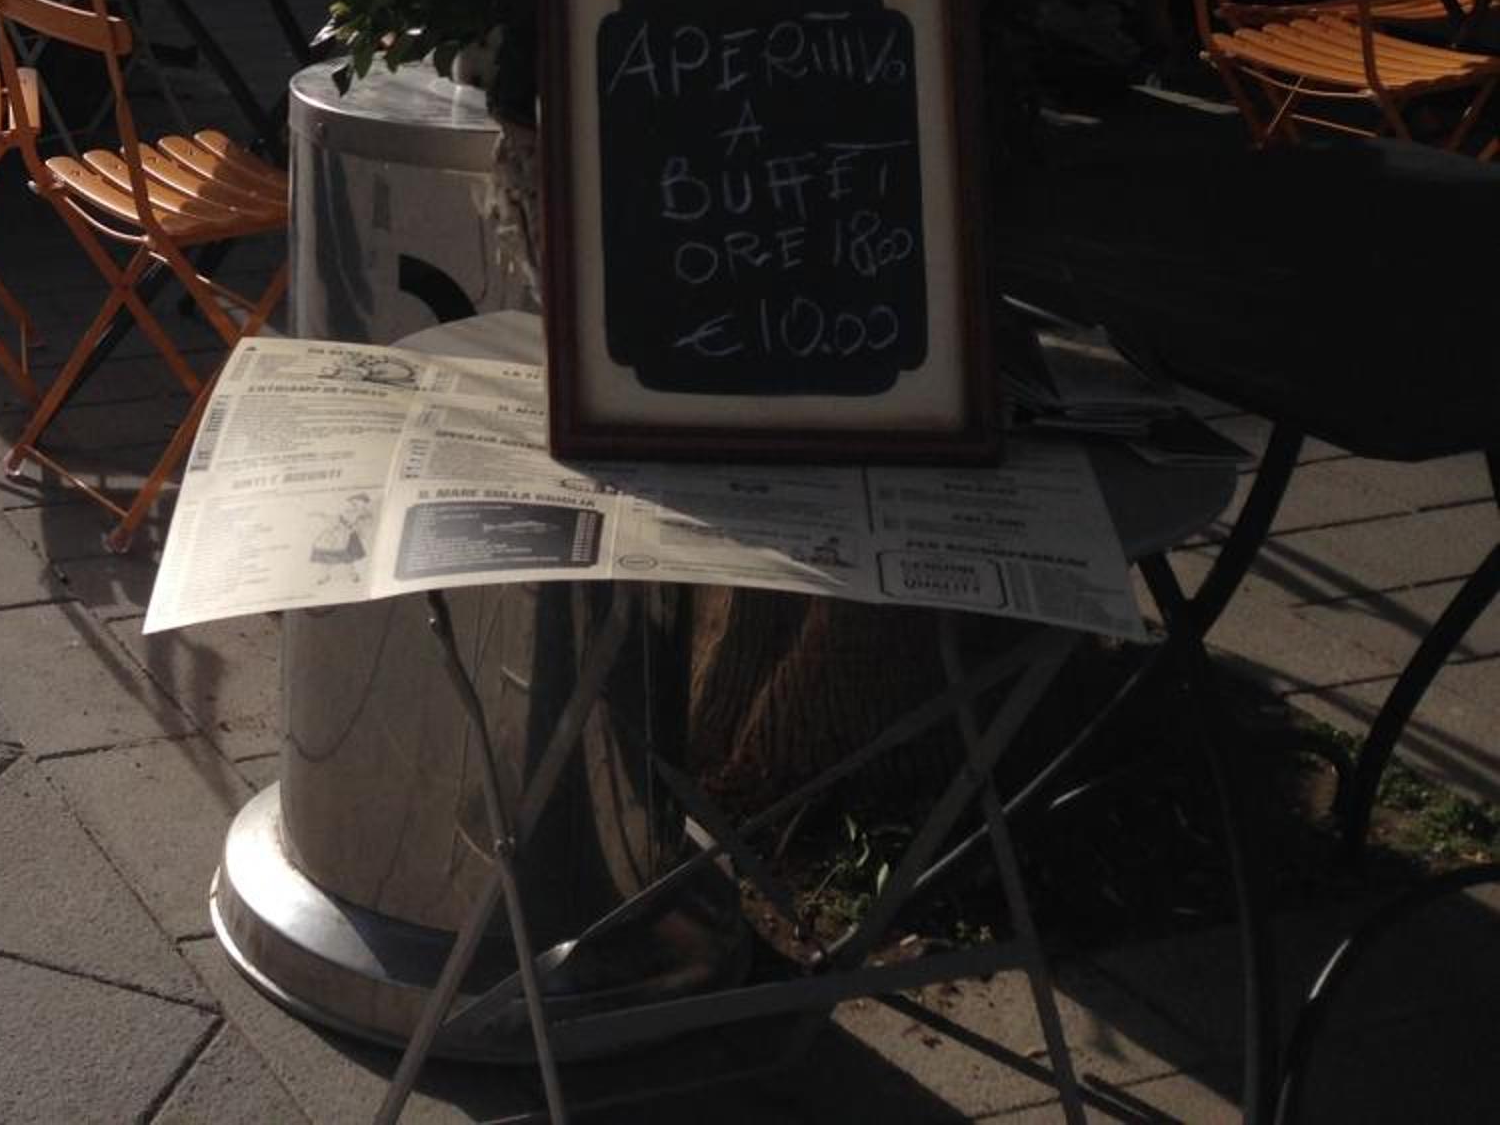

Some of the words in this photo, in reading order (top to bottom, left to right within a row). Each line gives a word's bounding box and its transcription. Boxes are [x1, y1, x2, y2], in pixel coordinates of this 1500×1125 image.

[607, 11, 908, 98] APERITIVO
[716, 99, 765, 155] A
[660, 138, 912, 221] BUFFET
[674, 225, 807, 284] ORE
